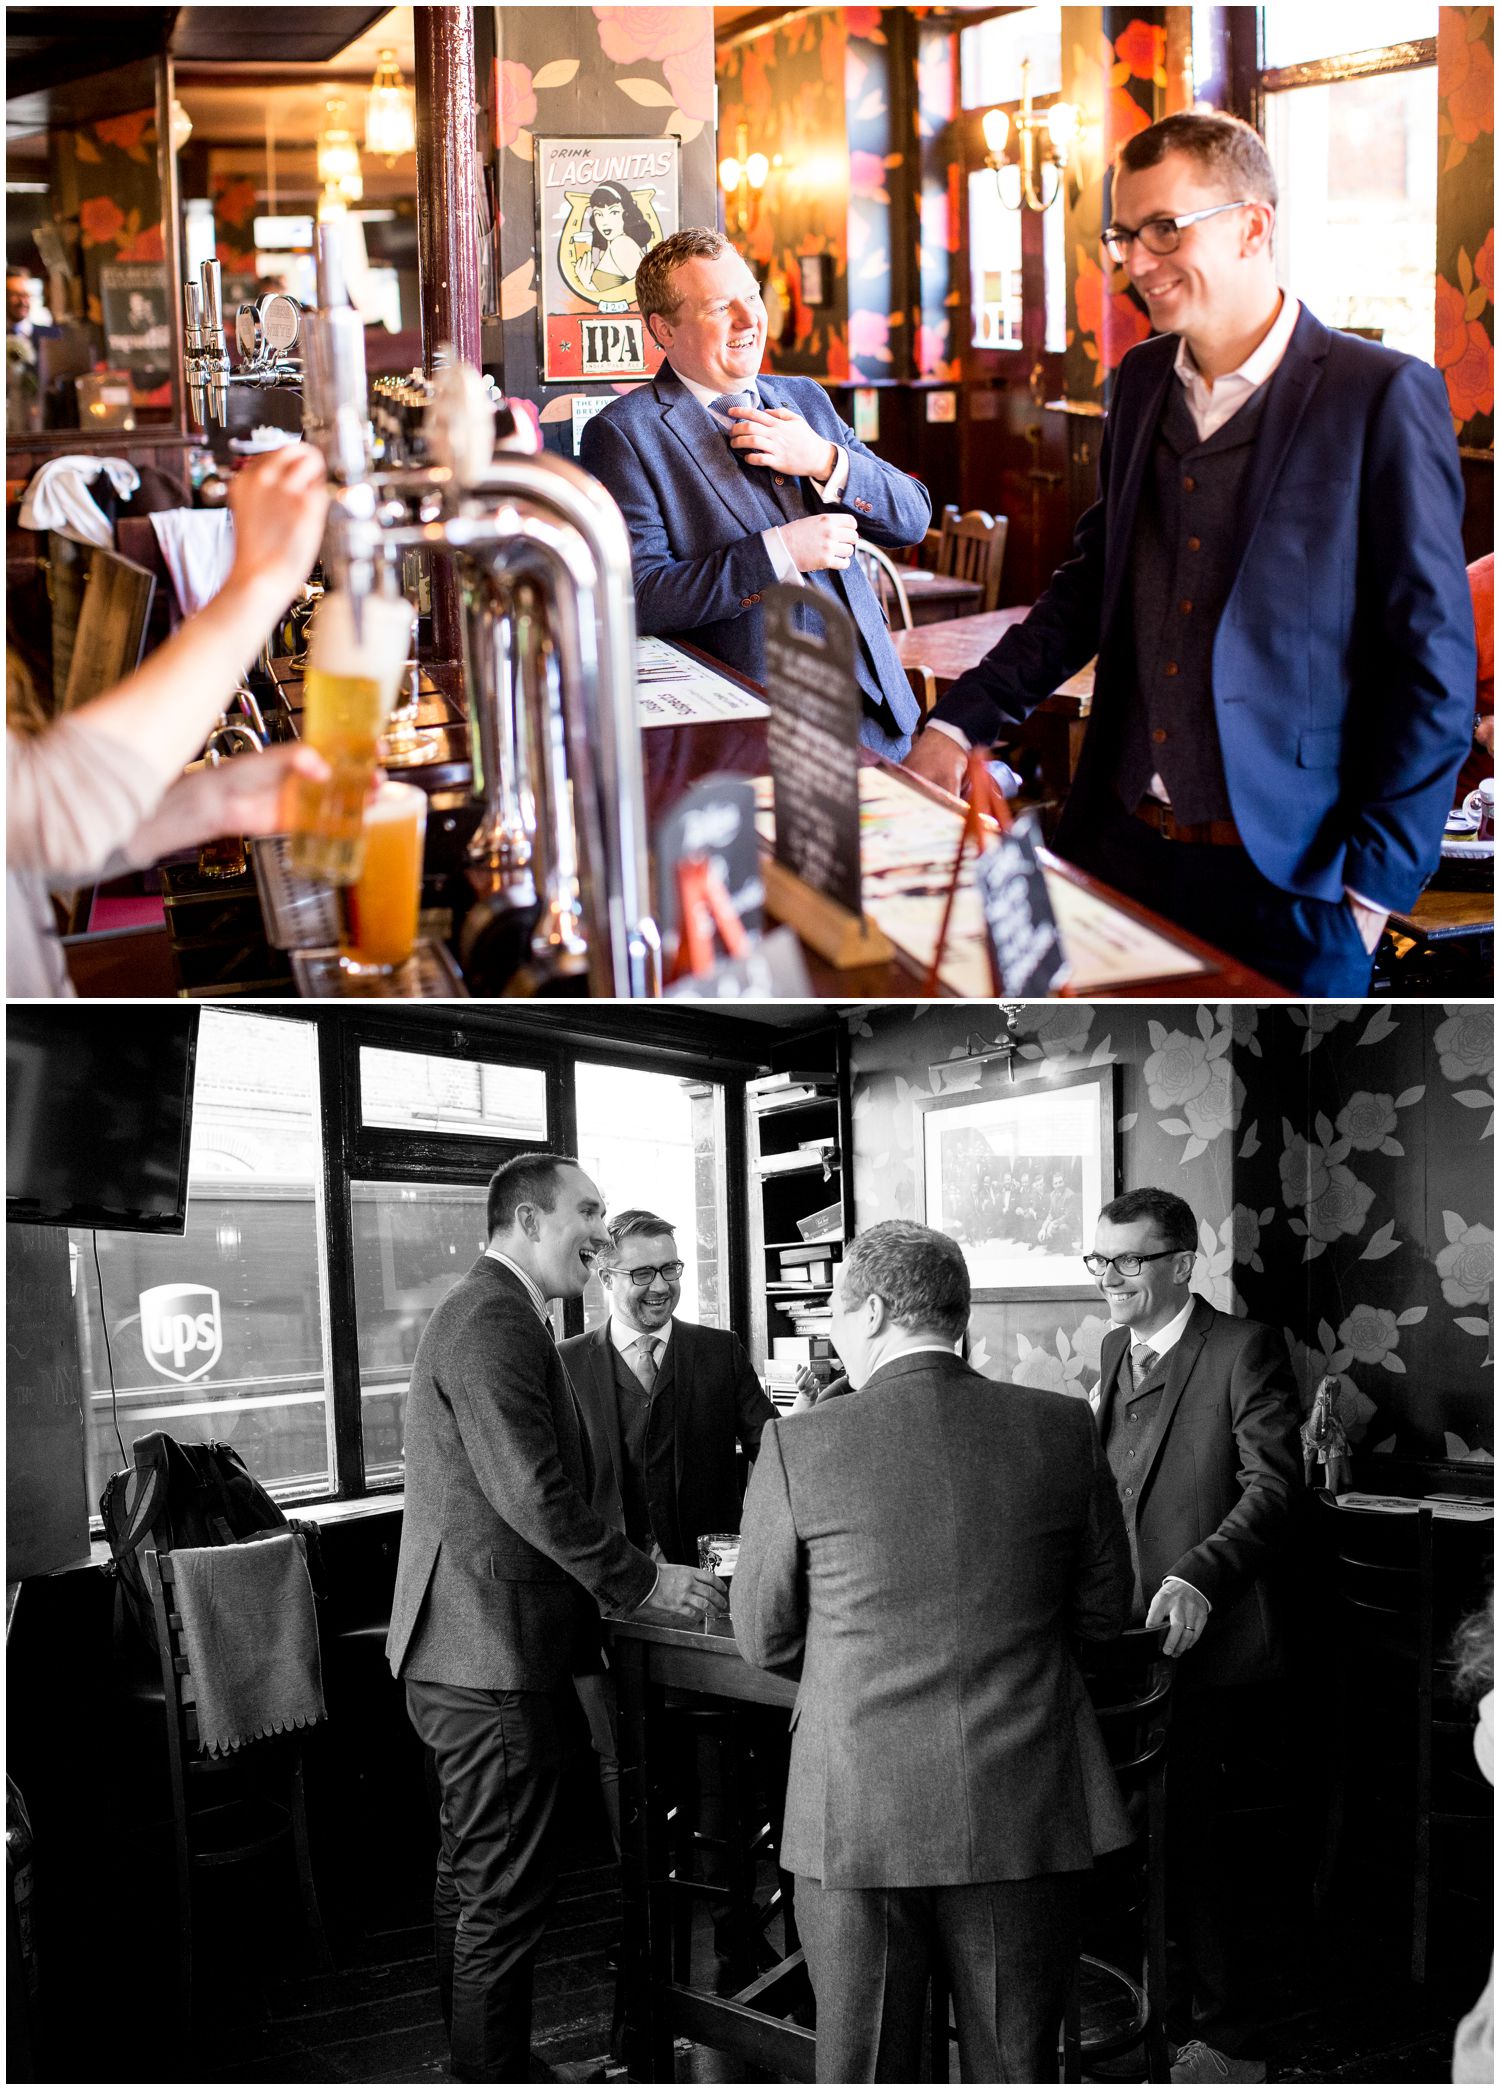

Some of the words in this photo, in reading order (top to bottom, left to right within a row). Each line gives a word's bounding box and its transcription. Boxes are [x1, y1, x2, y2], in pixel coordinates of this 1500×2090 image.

[545, 152, 673, 188] LAGUNITAS
[550, 148, 591, 159] DRINK
[585, 325, 641, 363] IPA
[149, 1312, 216, 1368] ups
